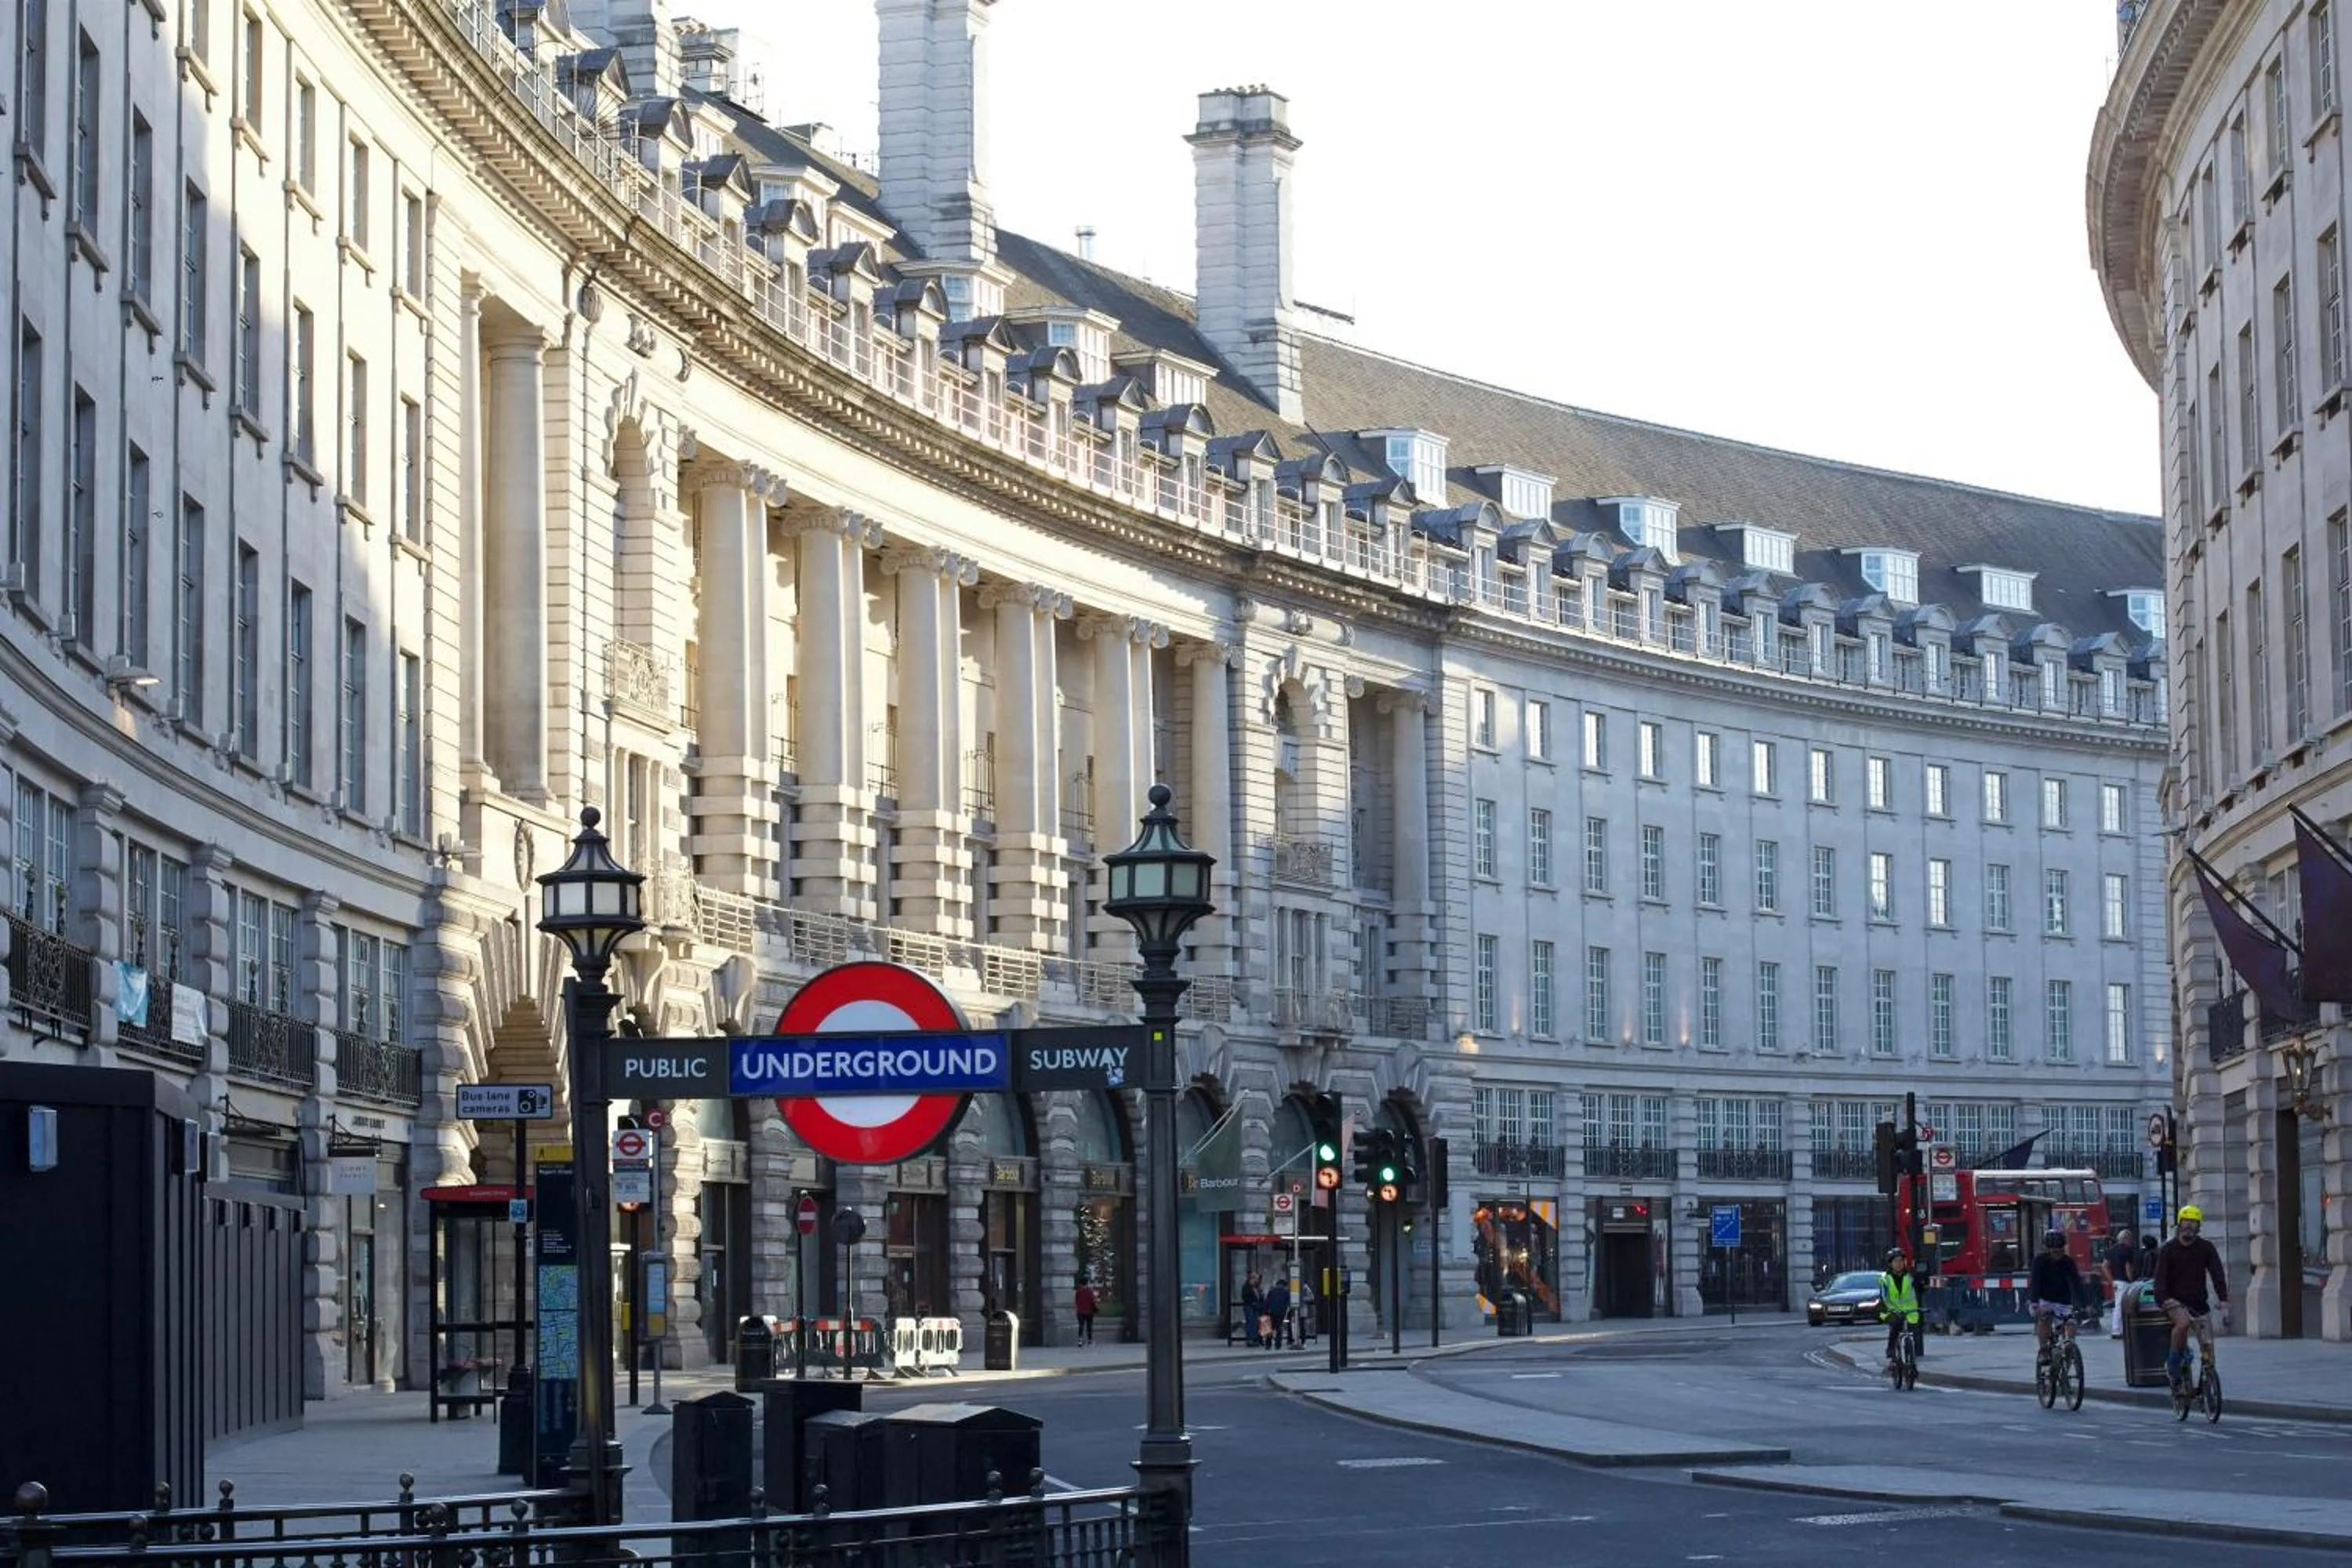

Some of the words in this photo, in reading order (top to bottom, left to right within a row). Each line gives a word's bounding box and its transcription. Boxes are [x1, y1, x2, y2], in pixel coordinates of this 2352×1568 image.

[742, 1048, 997, 1080] UNDERGROUND
[1029, 1046, 1129, 1070] SUBWAY
[625, 1058, 706, 1078] PUBLIC
[462, 1091, 482, 1101] Bus
[487, 1091, 511, 1101] lane
[462, 1105, 510, 1114] cameras
[648, 1112, 662, 1127] C
[1200, 1178, 1238, 1189] Barbour
